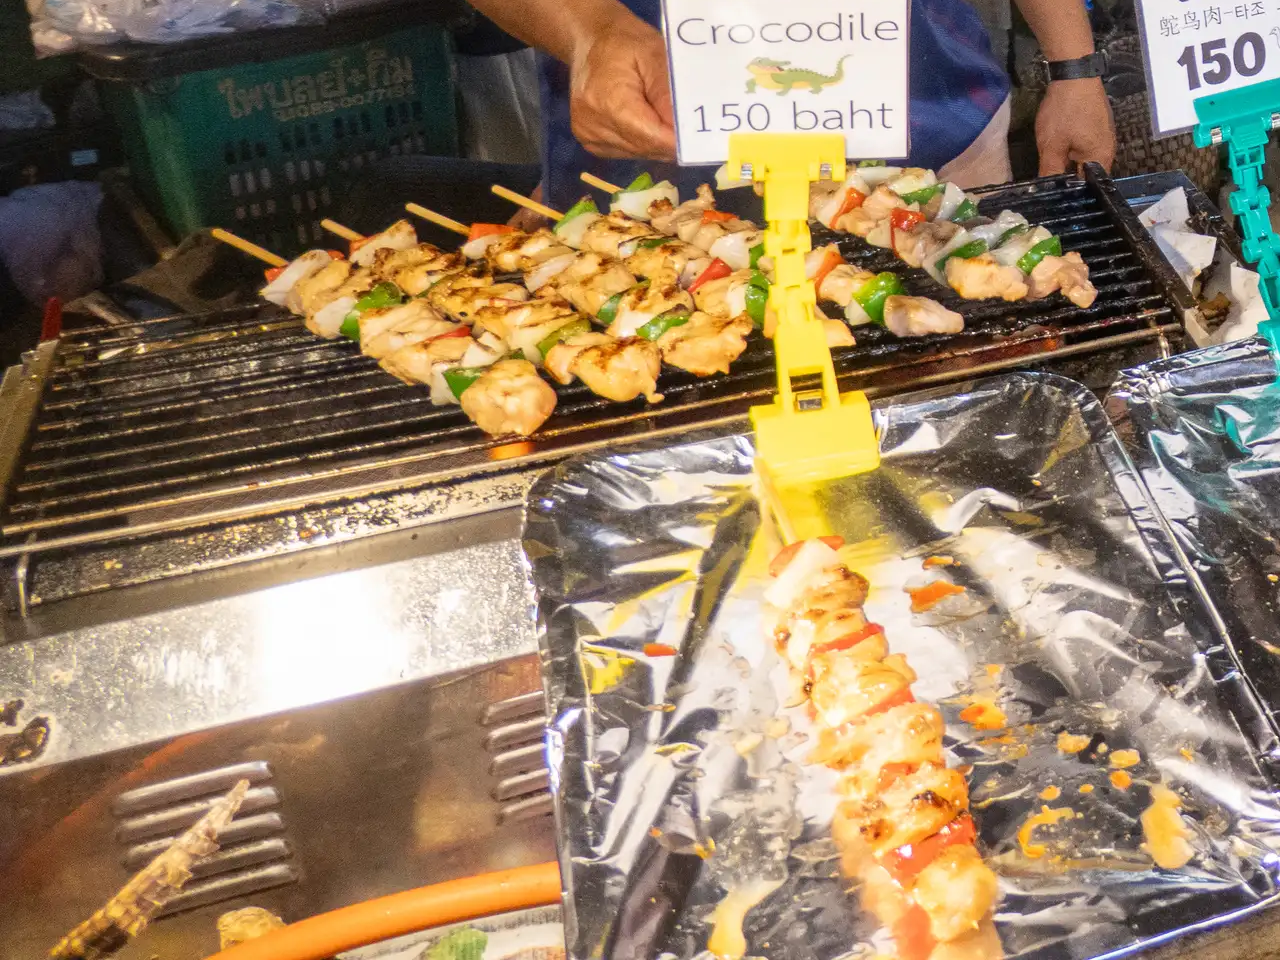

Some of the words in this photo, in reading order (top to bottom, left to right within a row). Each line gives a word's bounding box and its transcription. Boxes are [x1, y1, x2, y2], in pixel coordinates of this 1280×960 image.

[676, 13, 899, 46] Crocodile
[1176, 31, 1267, 91] 150
[693, 102, 771, 133] 150
[792, 100, 894, 131] baht
